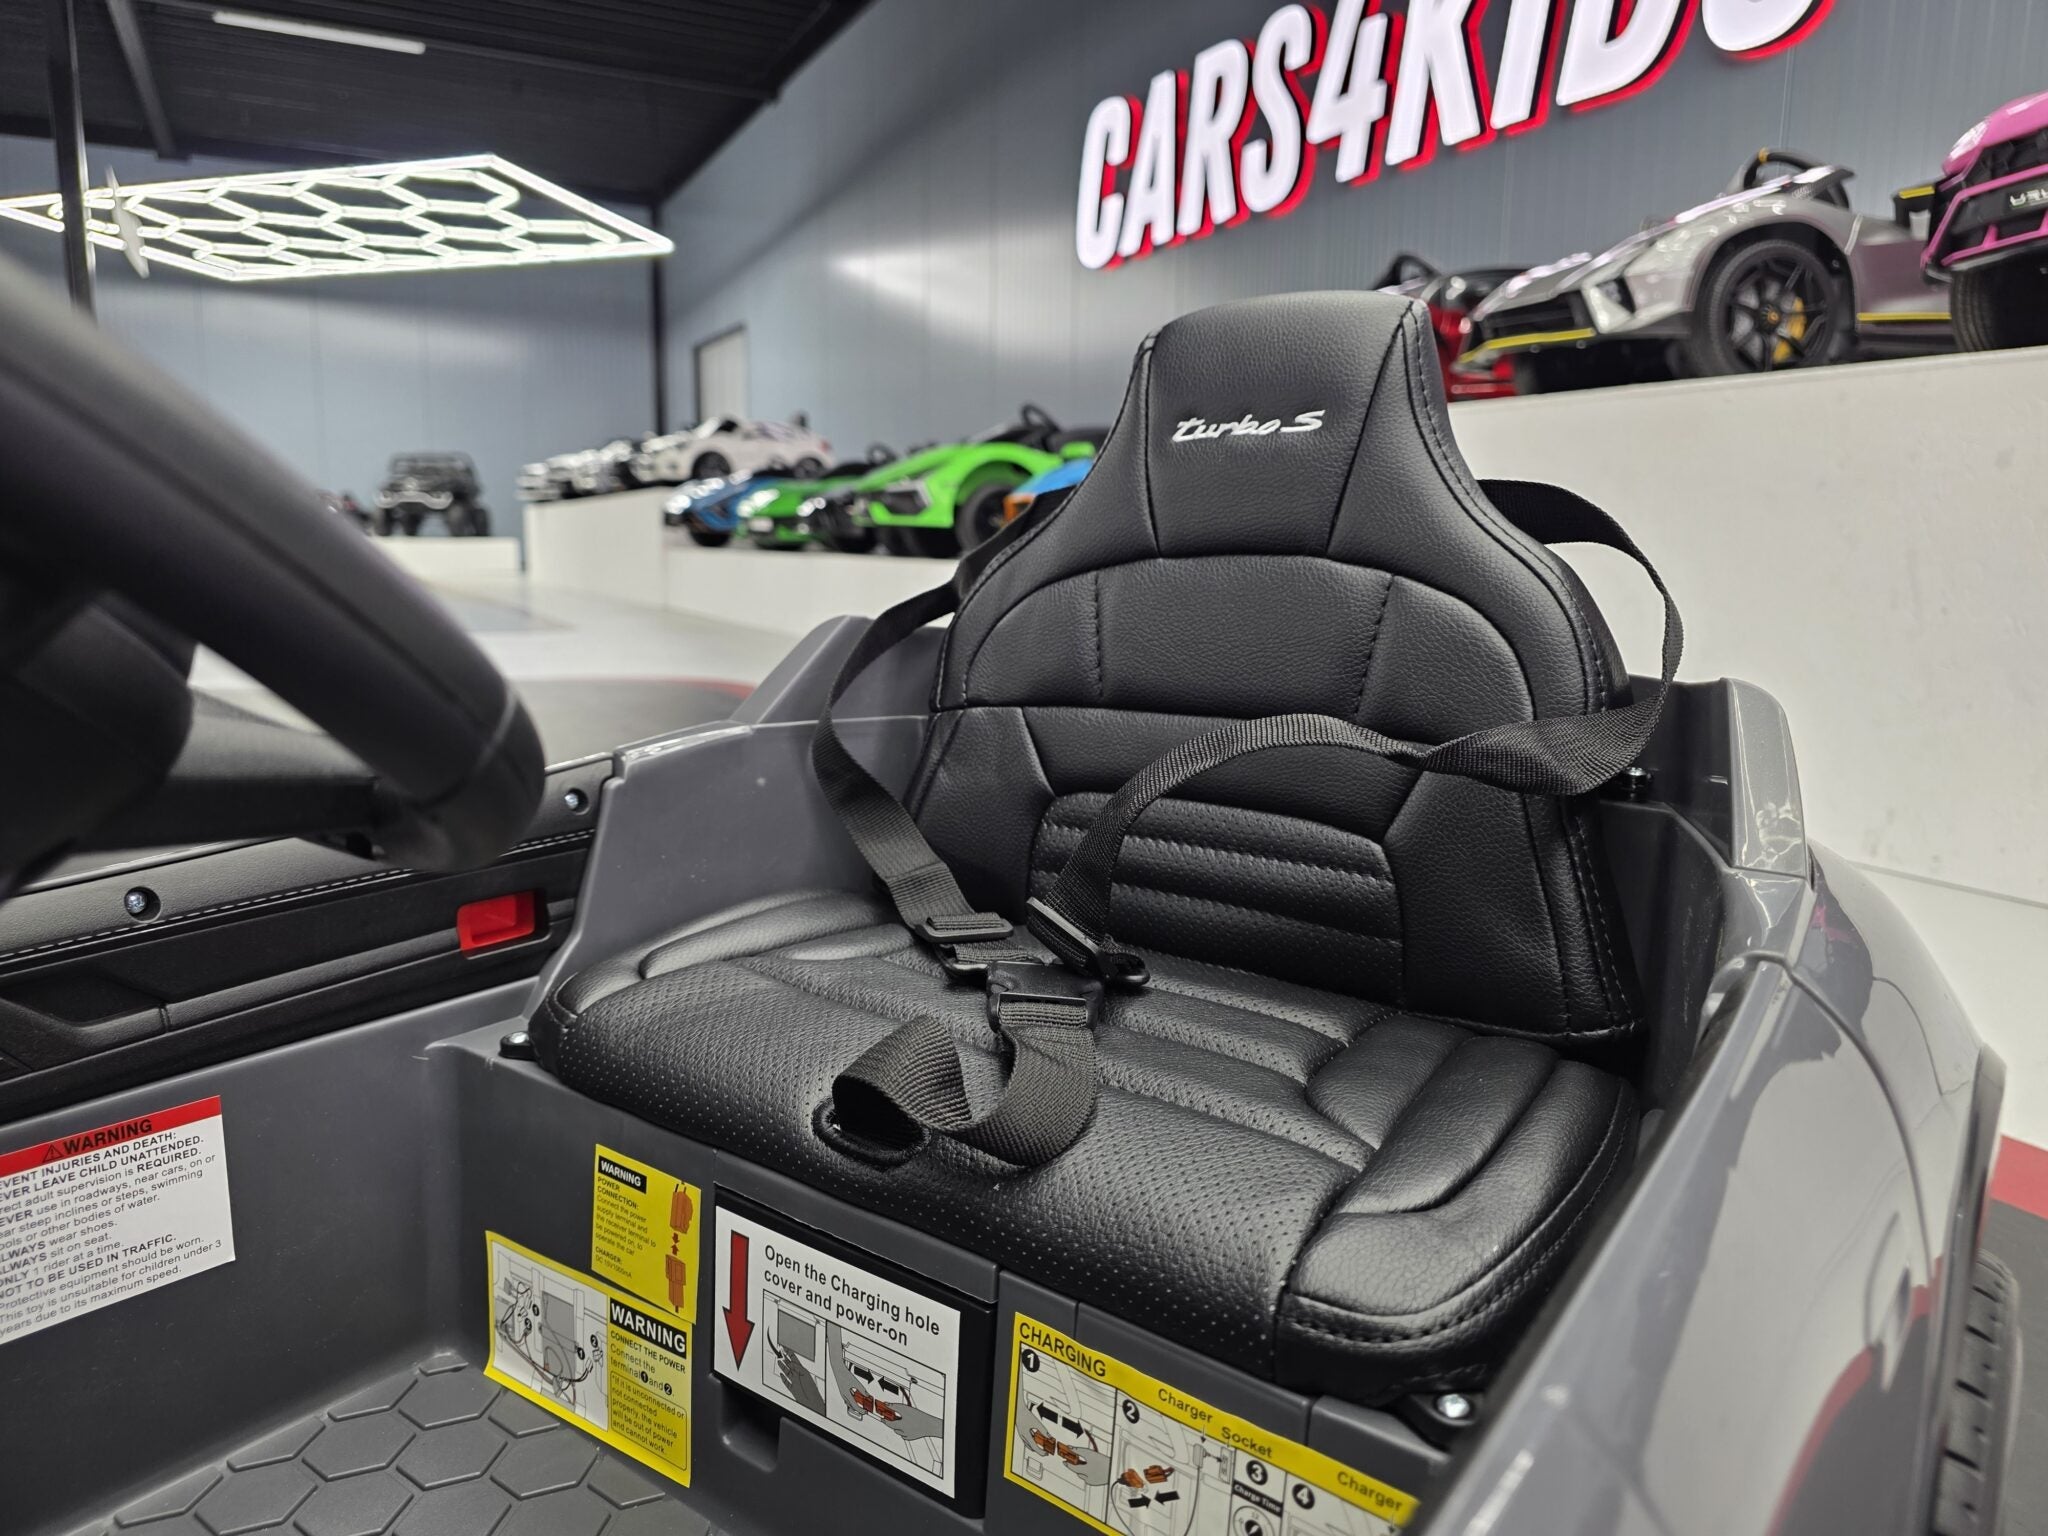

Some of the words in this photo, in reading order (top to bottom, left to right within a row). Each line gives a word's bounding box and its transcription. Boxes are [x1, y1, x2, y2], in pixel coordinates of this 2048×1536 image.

[1172, 414, 1281, 443] turbo
[1280, 410, 1326, 433] S
[42, 1153, 100, 1177] INJURIES
[104, 1145, 129, 1159] AND
[134, 1132, 176, 1150] DEATH:
[63, 1119, 152, 1154] WARNING
[25, 1191, 54, 1207] adult
[57, 1172, 121, 1197] supervision
[124, 1167, 134, 1176] is
[137, 1148, 201, 1173] REQUIRED.
[34, 1172, 76, 1192] LEAVE
[80, 1160, 117, 1177] CHILD
[121, 1136, 203, 1165] UNATTENDED.
[600, 1160, 641, 1187] WARNING
[19, 1217, 51, 1233] steep
[55, 1203, 98, 1220] inclines
[102, 1197, 113, 1206] or
[115, 1187, 148, 1202] steps,
[151, 1169, 203, 1191] swimming
[36, 1204, 57, 1215] use
[61, 1198, 71, 1207] in
[75, 1181, 131, 1204] roadways,
[134, 1172, 159, 1185] near
[161, 1165, 187, 1176] cars,
[190, 1159, 202, 1168] on
[205, 1154, 216, 1163] or
[25, 1232, 37, 1241] or
[41, 1221, 71, 1237] other
[74, 1209, 111, 1226] bodies
[114, 1204, 125, 1213] of
[127, 1194, 160, 1209] water.
[597, 1195, 619, 1210] Connect
[630, 1210, 647, 1223] power
[48, 1231, 77, 1246] wear
[80, 1220, 117, 1236] shoes.
[50, 1248, 64, 1258] sit
[67, 1242, 81, 1252] on
[84, 1232, 112, 1247] seat.
[0, 1287, 56, 1310] Protective
[59, 1264, 119, 1291] equipment
[122, 1252, 157, 1269] should
[160, 1247, 173, 1257] be
[176, 1236, 204, 1251] worn.
[27, 1277, 44, 1289] TO
[48, 1270, 65, 1283] BE
[68, 1257, 103, 1275] USED
[107, 1252, 119, 1263] IN
[122, 1234, 176, 1257] TRAFFIC.
[33, 1267, 39, 1275] 1
[43, 1257, 70, 1273] rider
[73, 1252, 84, 1263] at
[87, 1250, 94, 1258] a
[0, 1309, 23, 1323] This
[27, 1302, 45, 1315] toy
[48, 1297, 57, 1307] is
[60, 1276, 119, 1302] unsuitable
[121, 1270, 136, 1281] for
[139, 1254, 181, 1275] children
[183, 1243, 213, 1260] under
[215, 1239, 221, 1248] 3
[764, 1245, 800, 1274] Open
[804, 1262, 827, 1285] the
[831, 1274, 900, 1321] Charging
[905, 1310, 940, 1335] hole
[0, 1319, 32, 1336] years
[35, 1310, 57, 1323] due
[60, 1304, 71, 1314] to
[74, 1299, 87, 1309] its
[90, 1279, 144, 1303] maximum
[146, 1266, 182, 1283] speed.
[764, 1268, 802, 1297] cover
[805, 1285, 832, 1311] and
[836, 1302, 908, 1346] power-on
[611, 1303, 686, 1353] WARNING
[610, 1330, 642, 1352] CONNECT
[643, 1346, 657, 1360] THE
[659, 1354, 686, 1373] POWER
[610, 1343, 642, 1367] Connect
[642, 1359, 655, 1373] the
[1019, 1322, 1107, 1377] CHARGING
[623, 1393, 657, 1416] connected
[632, 1387, 676, 1415] unconnected
[676, 1411, 684, 1419] or
[1158, 1388, 1213, 1424] Charger
[625, 1426, 648, 1445] cannot
[641, 1413, 652, 1425] the
[653, 1421, 677, 1439] vehicle
[652, 1431, 673, 1447] power
[1221, 1426, 1273, 1458] Socket
[1234, 1484, 1260, 1502] Charge
[1261, 1497, 1281, 1513] Time
[1337, 1471, 1402, 1512] Charger
